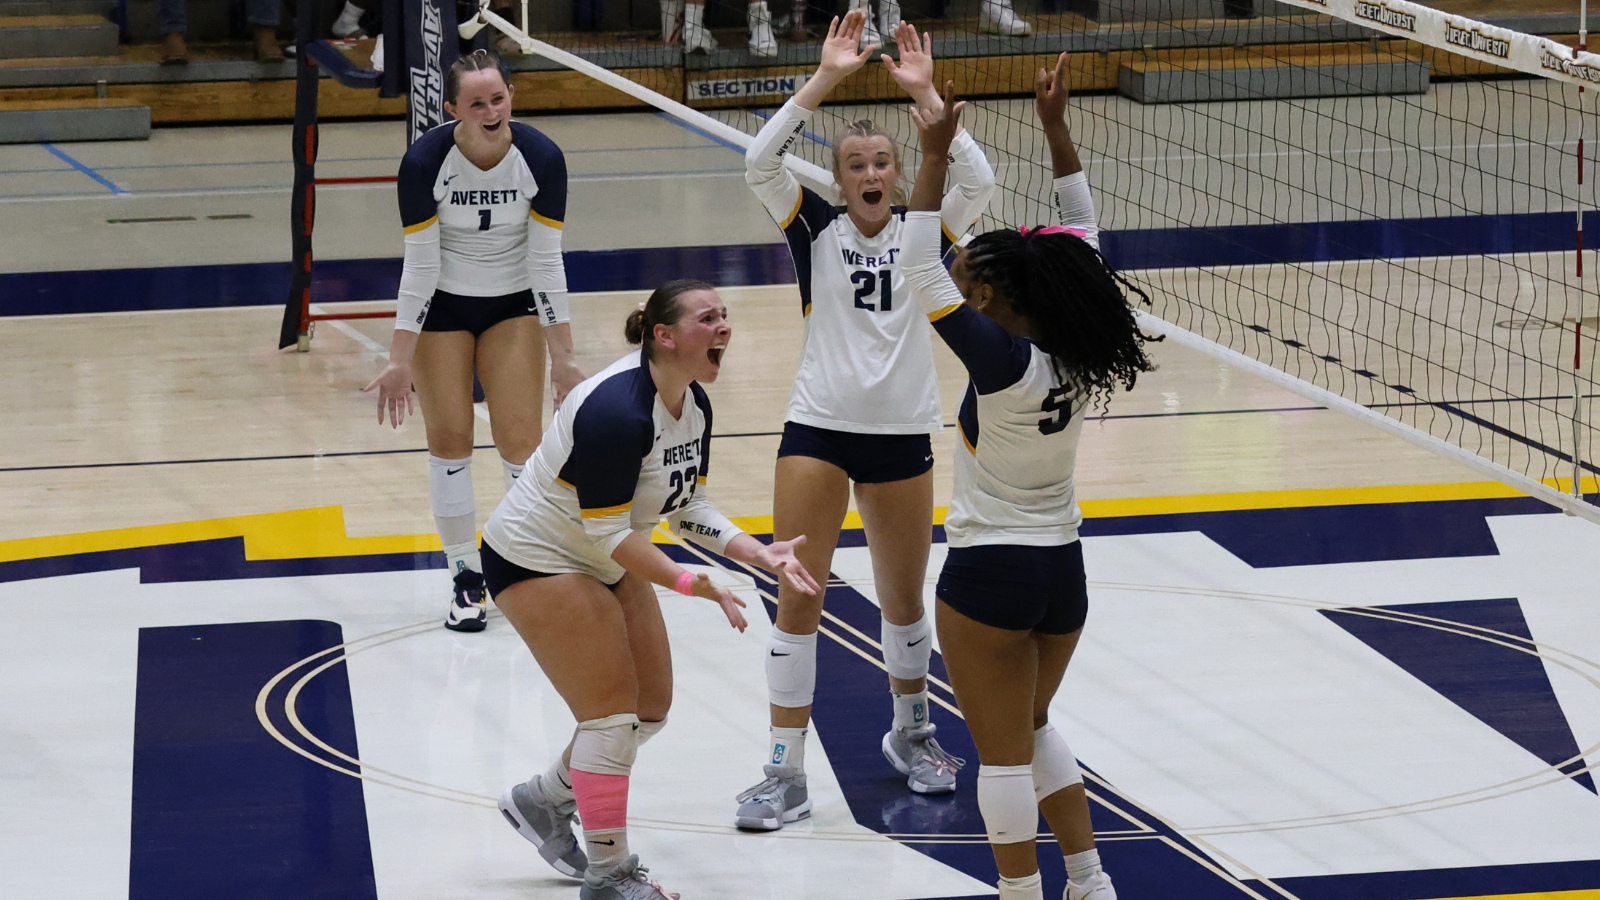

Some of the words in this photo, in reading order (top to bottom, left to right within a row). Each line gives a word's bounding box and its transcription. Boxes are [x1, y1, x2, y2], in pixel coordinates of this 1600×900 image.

[699, 78, 795, 96] SECTION
[792, 120, 806, 135] ONE
[776, 135, 796, 157] TEAM
[450, 189, 518, 205] AVERETT
[478, 209, 491, 231] 1
[538, 291, 551, 306] ONE
[850, 269, 892, 312] 21
[1038, 382, 1074, 436] 5
[659, 465, 698, 515] 23
[695, 523, 721, 539] TEAM
